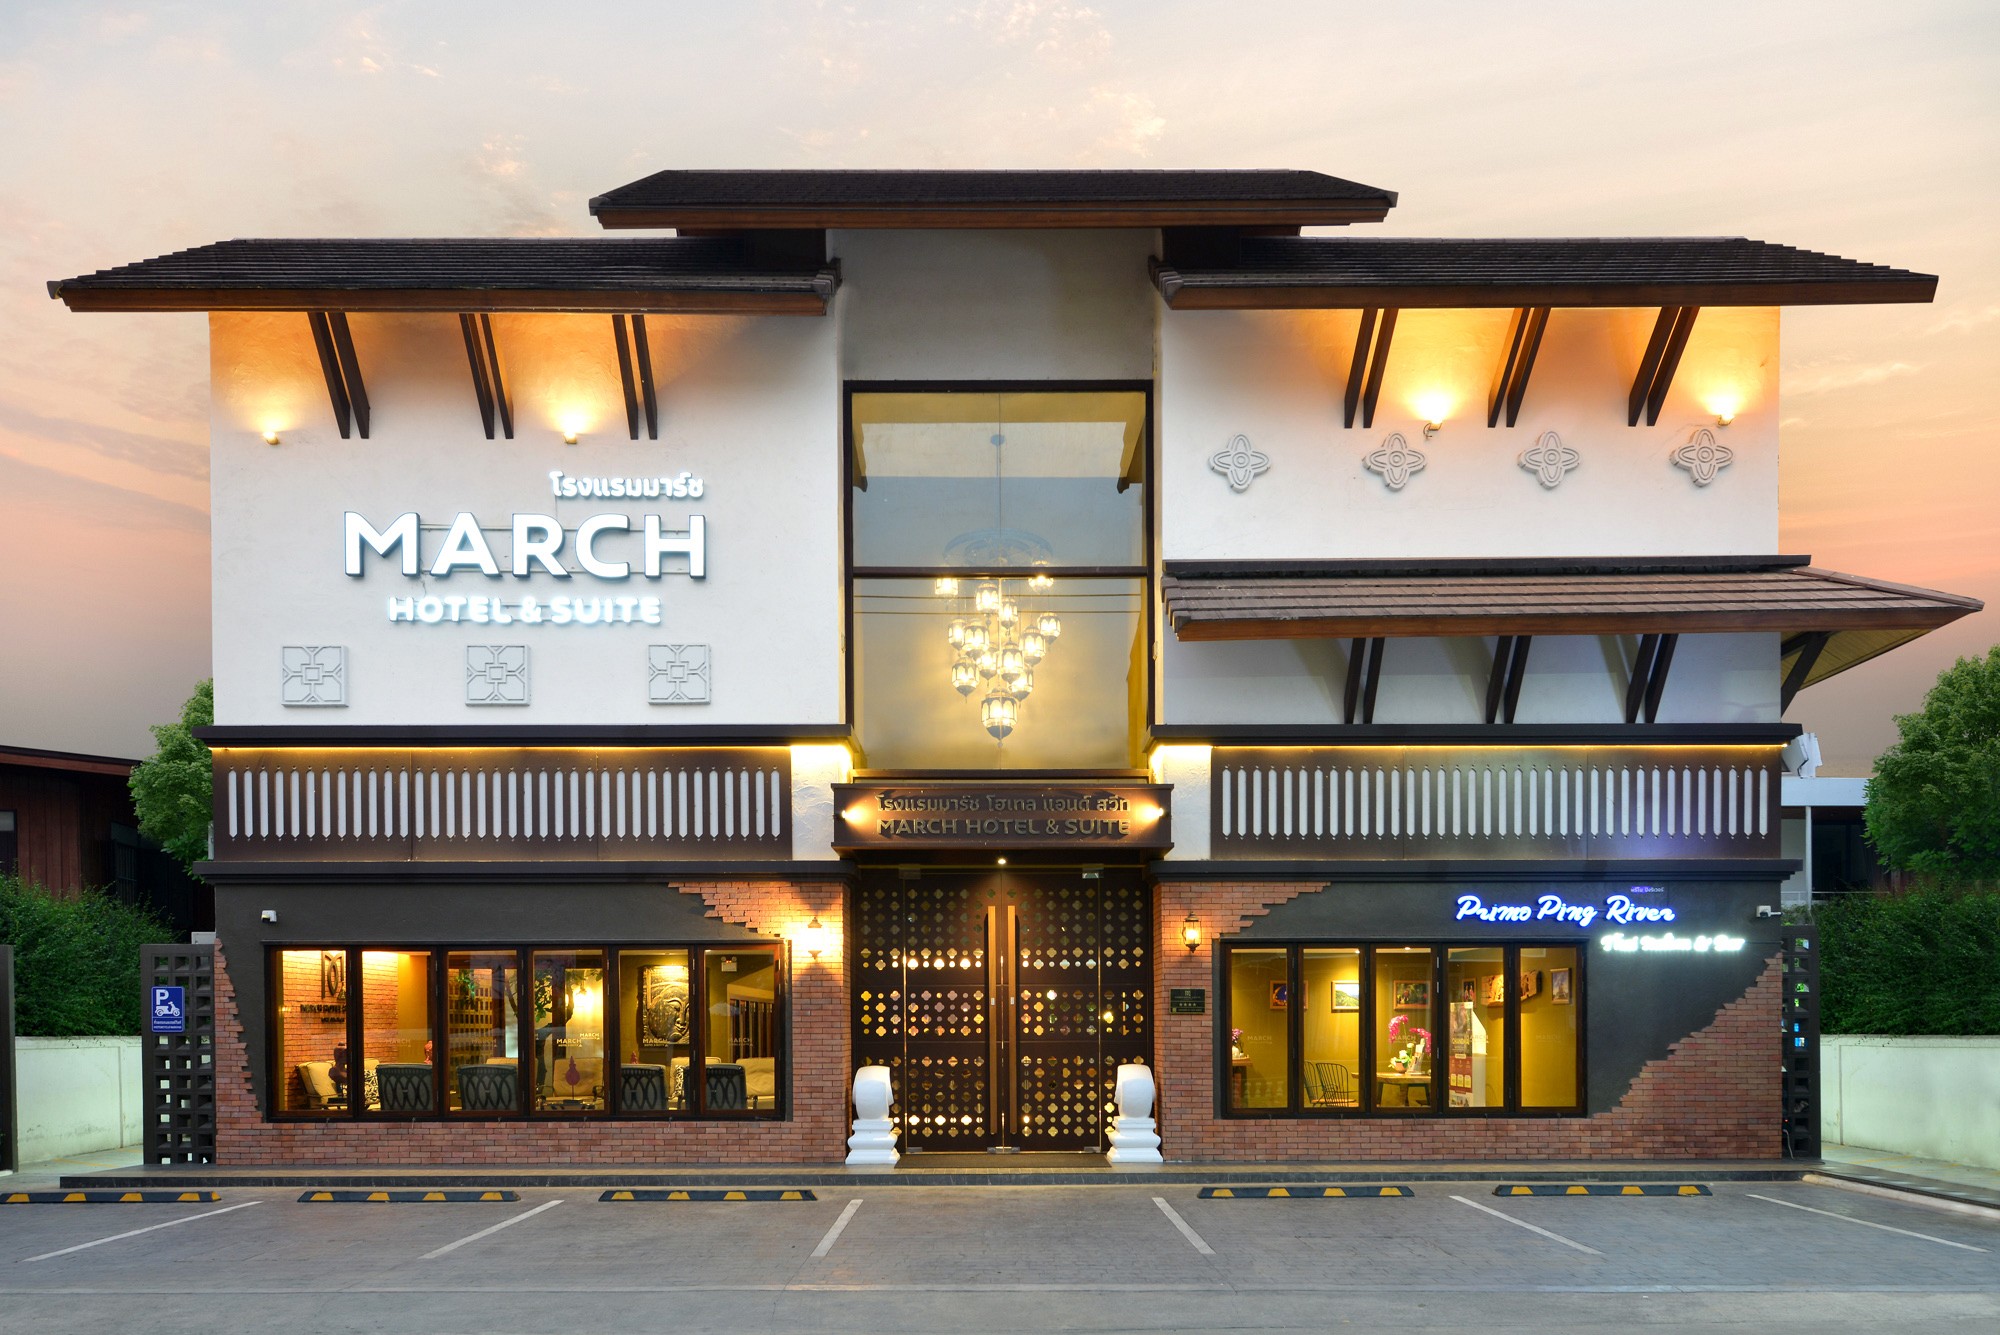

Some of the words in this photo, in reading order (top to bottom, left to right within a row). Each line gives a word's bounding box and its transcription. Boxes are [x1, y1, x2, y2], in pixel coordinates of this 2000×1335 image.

[549, 470, 705, 498] โรงแรมมาร์ช
[344, 511, 707, 579] MARCH
[389, 597, 513, 624] HOTEL
[520, 597, 542, 624] &
[551, 597, 662, 625] SUITE
[874, 795, 980, 812] โรงแรมมาร์ช
[986, 795, 1036, 812] โฮเทล
[1042, 795, 1092, 812] แอนด์
[876, 819, 957, 835] MARCH
[965, 819, 1041, 835] HOTEL
[1045, 819, 1059, 835] &
[1064, 819, 1131, 836] SUITE
[1456, 895, 1532, 922] Primo
[1537, 895, 1598, 927] Ping
[1606, 895, 1676, 925] River
[156, 989, 169, 1005] P
